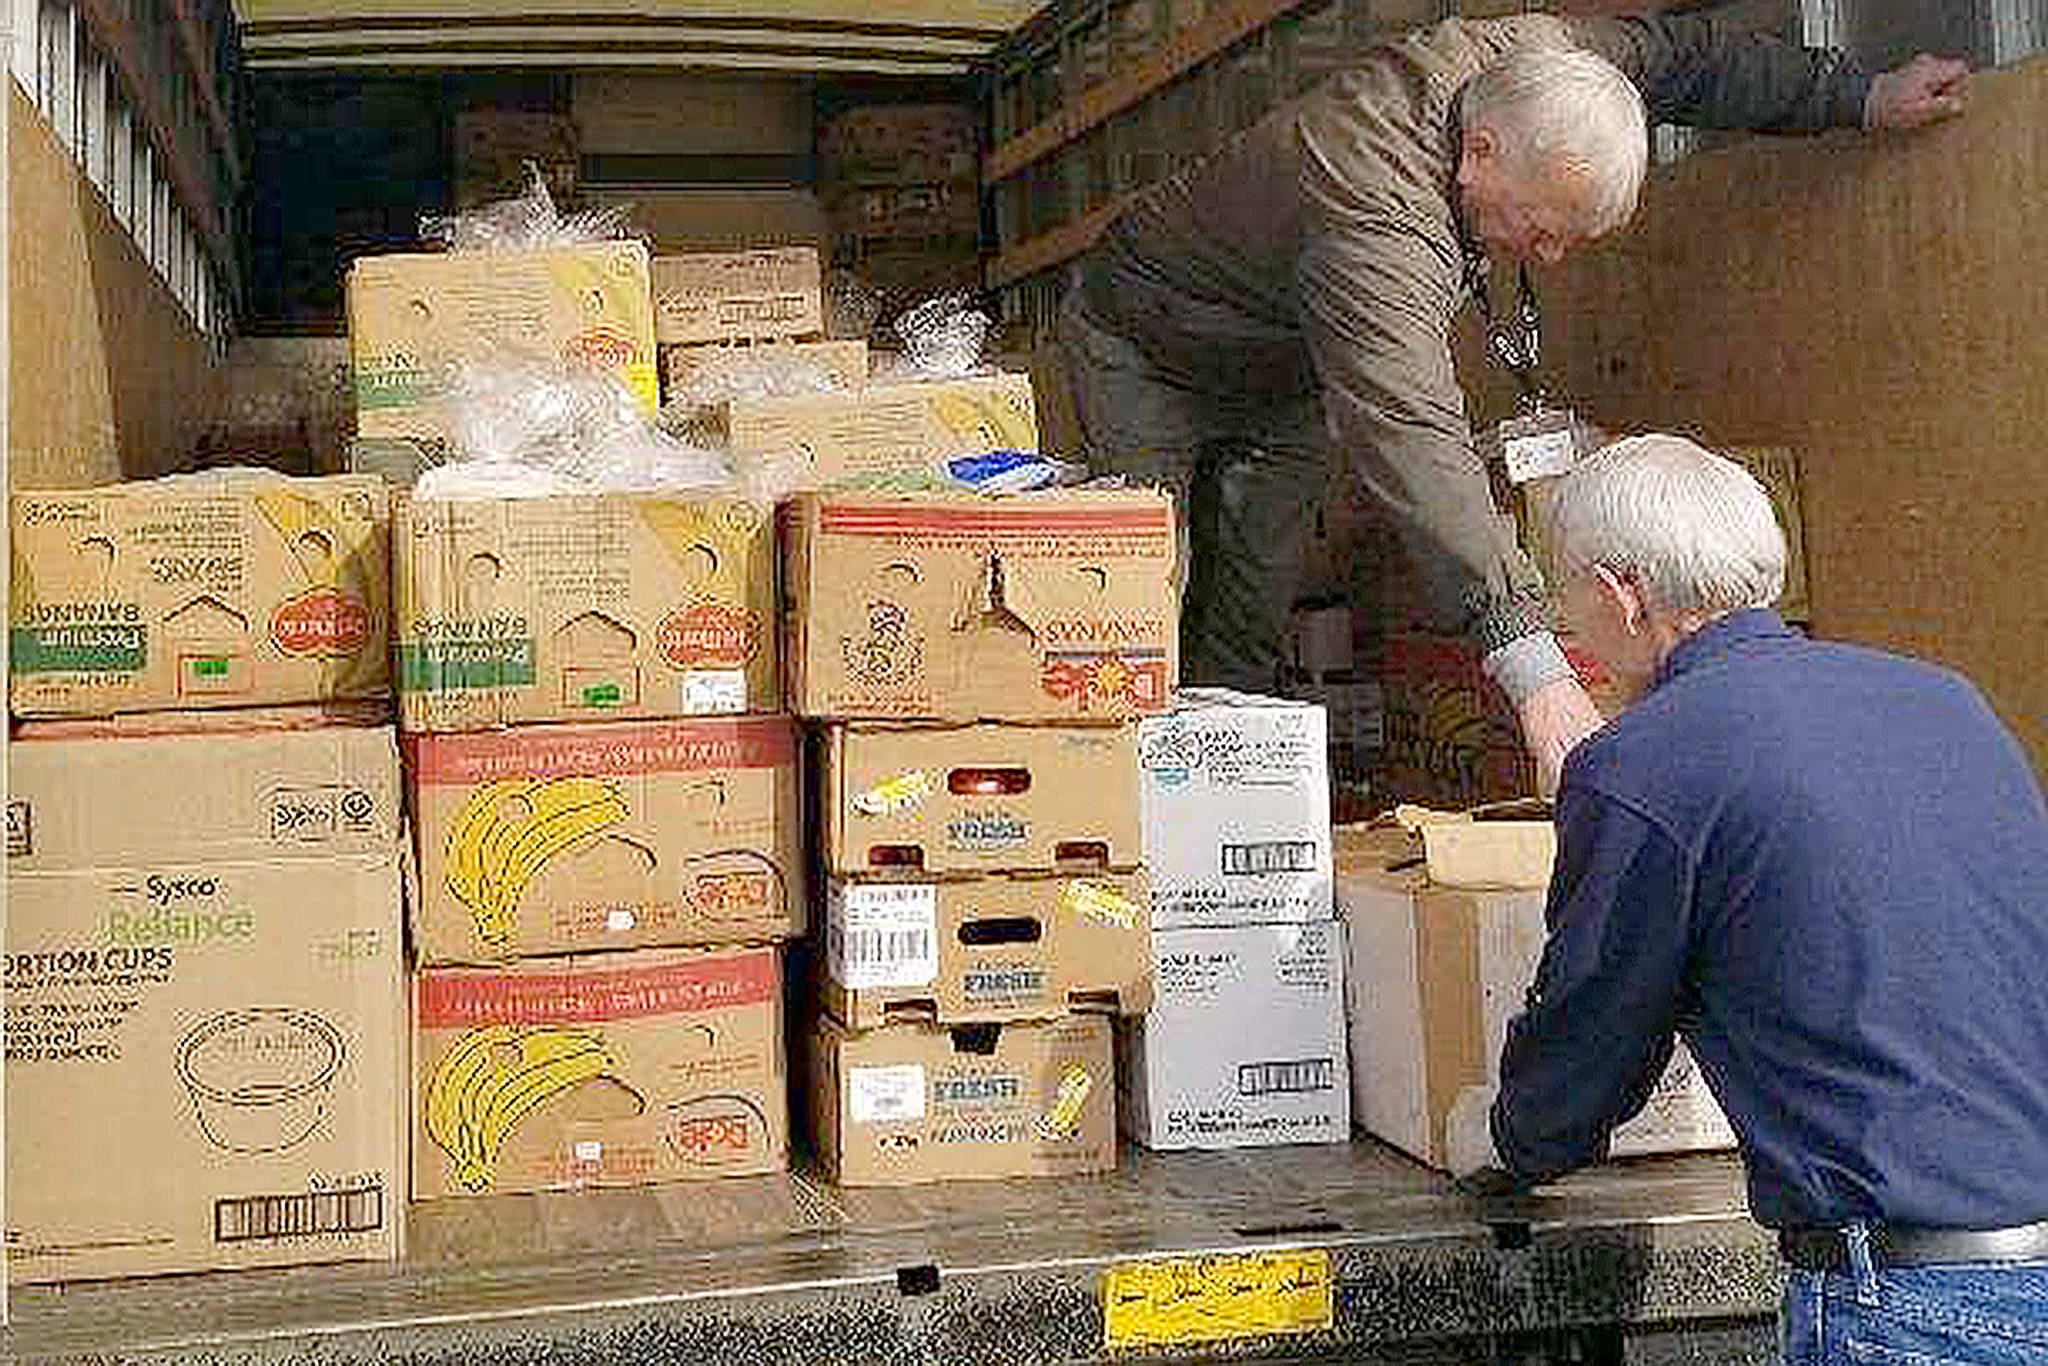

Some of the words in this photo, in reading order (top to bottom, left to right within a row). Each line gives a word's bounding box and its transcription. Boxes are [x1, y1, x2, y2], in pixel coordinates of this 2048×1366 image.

[21, 602, 141, 624] BANANAS
[36, 625, 141, 649] Premium
[1041, 660, 1168, 711] Dole
[146, 874, 219, 904] Sysco
[107, 905, 254, 940] Reliance
[104, 947, 173, 971] CUPS
